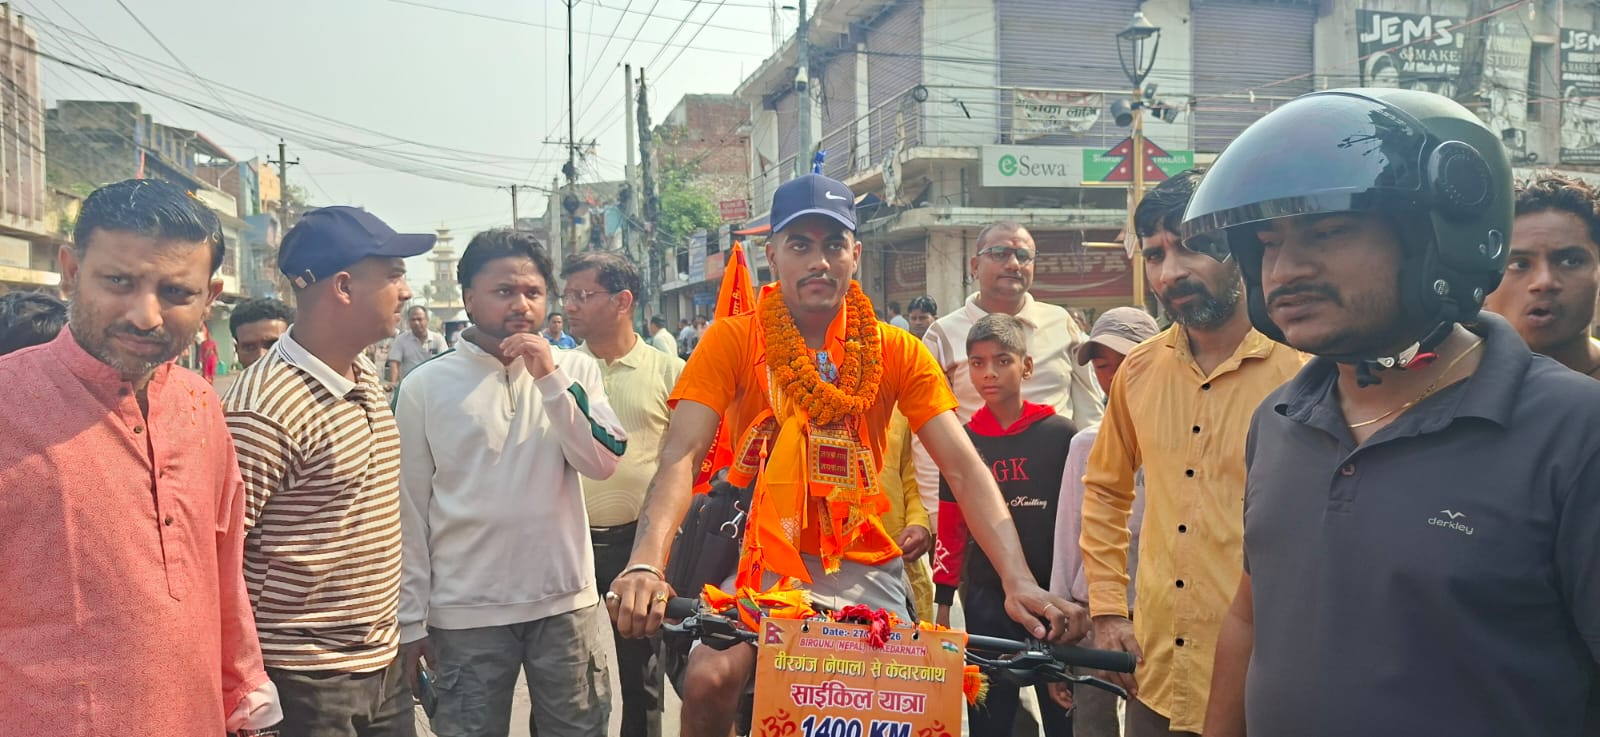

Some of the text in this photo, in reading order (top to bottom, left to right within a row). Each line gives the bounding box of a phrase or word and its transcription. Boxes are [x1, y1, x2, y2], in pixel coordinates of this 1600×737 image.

[1360, 14, 1453, 46] JEMS
[998, 154, 1067, 177] eSewa
[1427, 517, 1474, 535] derkley
[800, 638, 834, 648] BIRGUNJ
[871, 657, 883, 678] से
[886, 659, 947, 682] केदारनाथ
[879, 690, 926, 713] यात्रा
[802, 715, 862, 737] 1400
